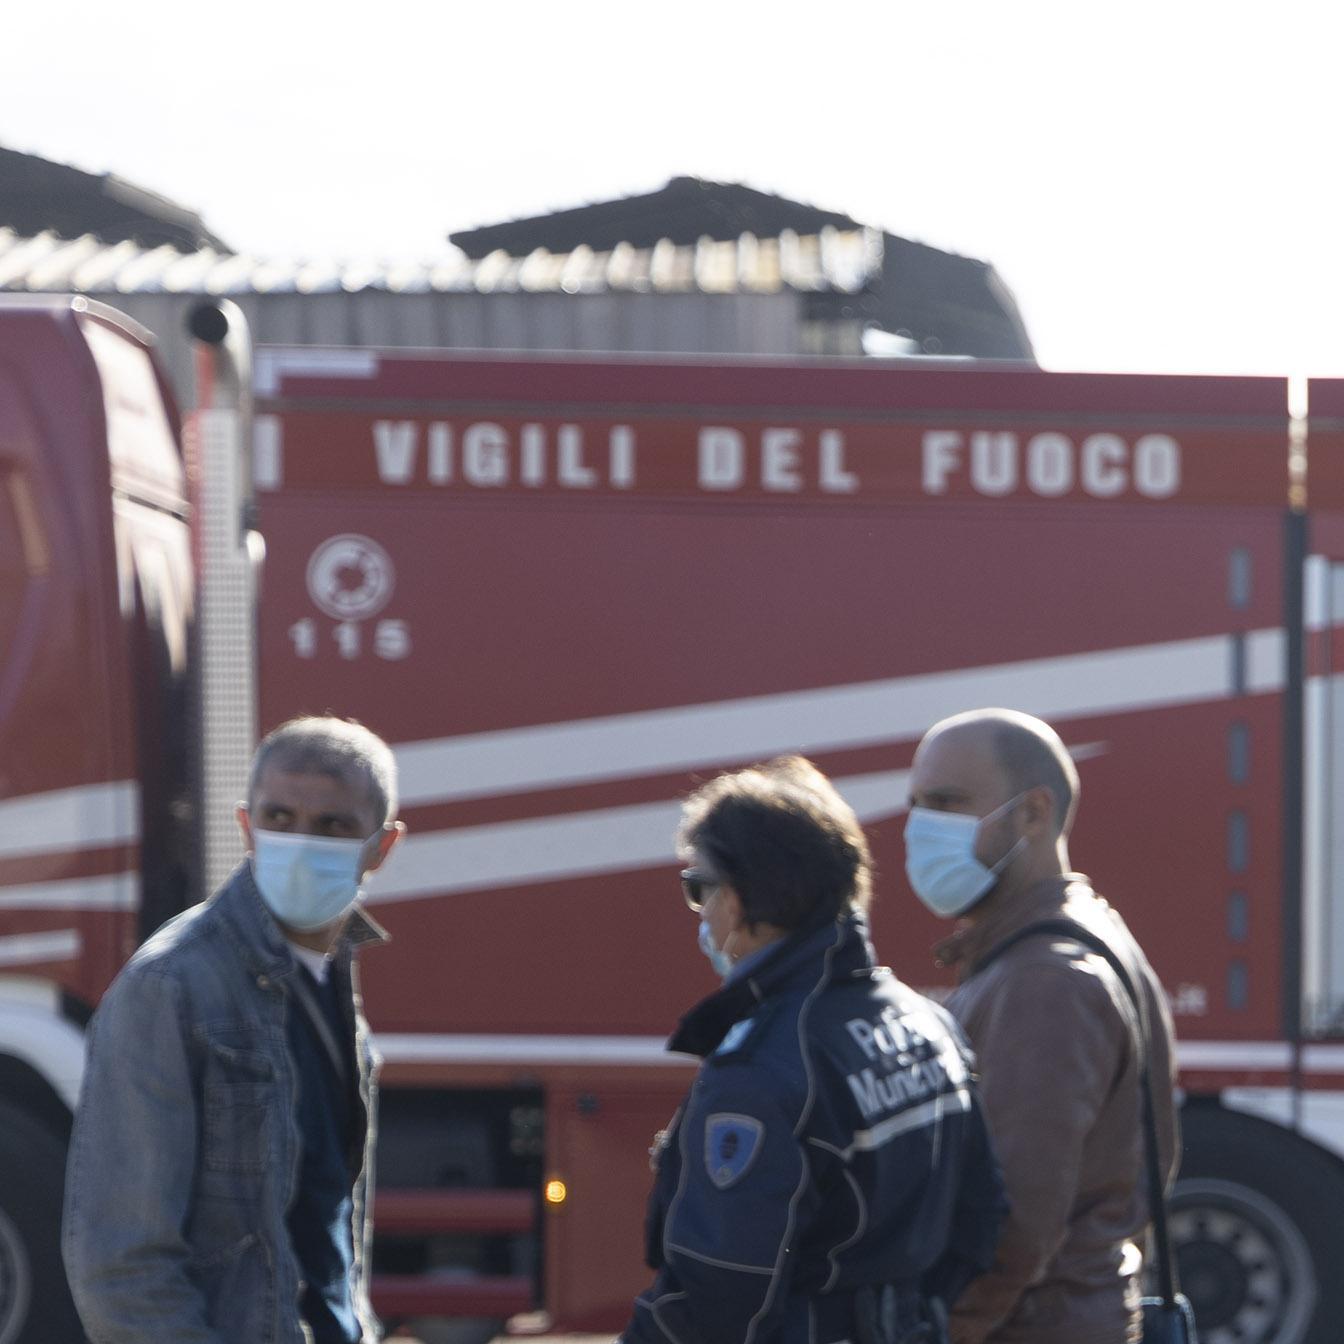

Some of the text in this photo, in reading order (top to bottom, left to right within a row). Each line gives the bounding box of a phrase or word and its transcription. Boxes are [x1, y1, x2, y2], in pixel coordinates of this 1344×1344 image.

[372, 420, 1182, 499] VIGILI DEL FUOCO
